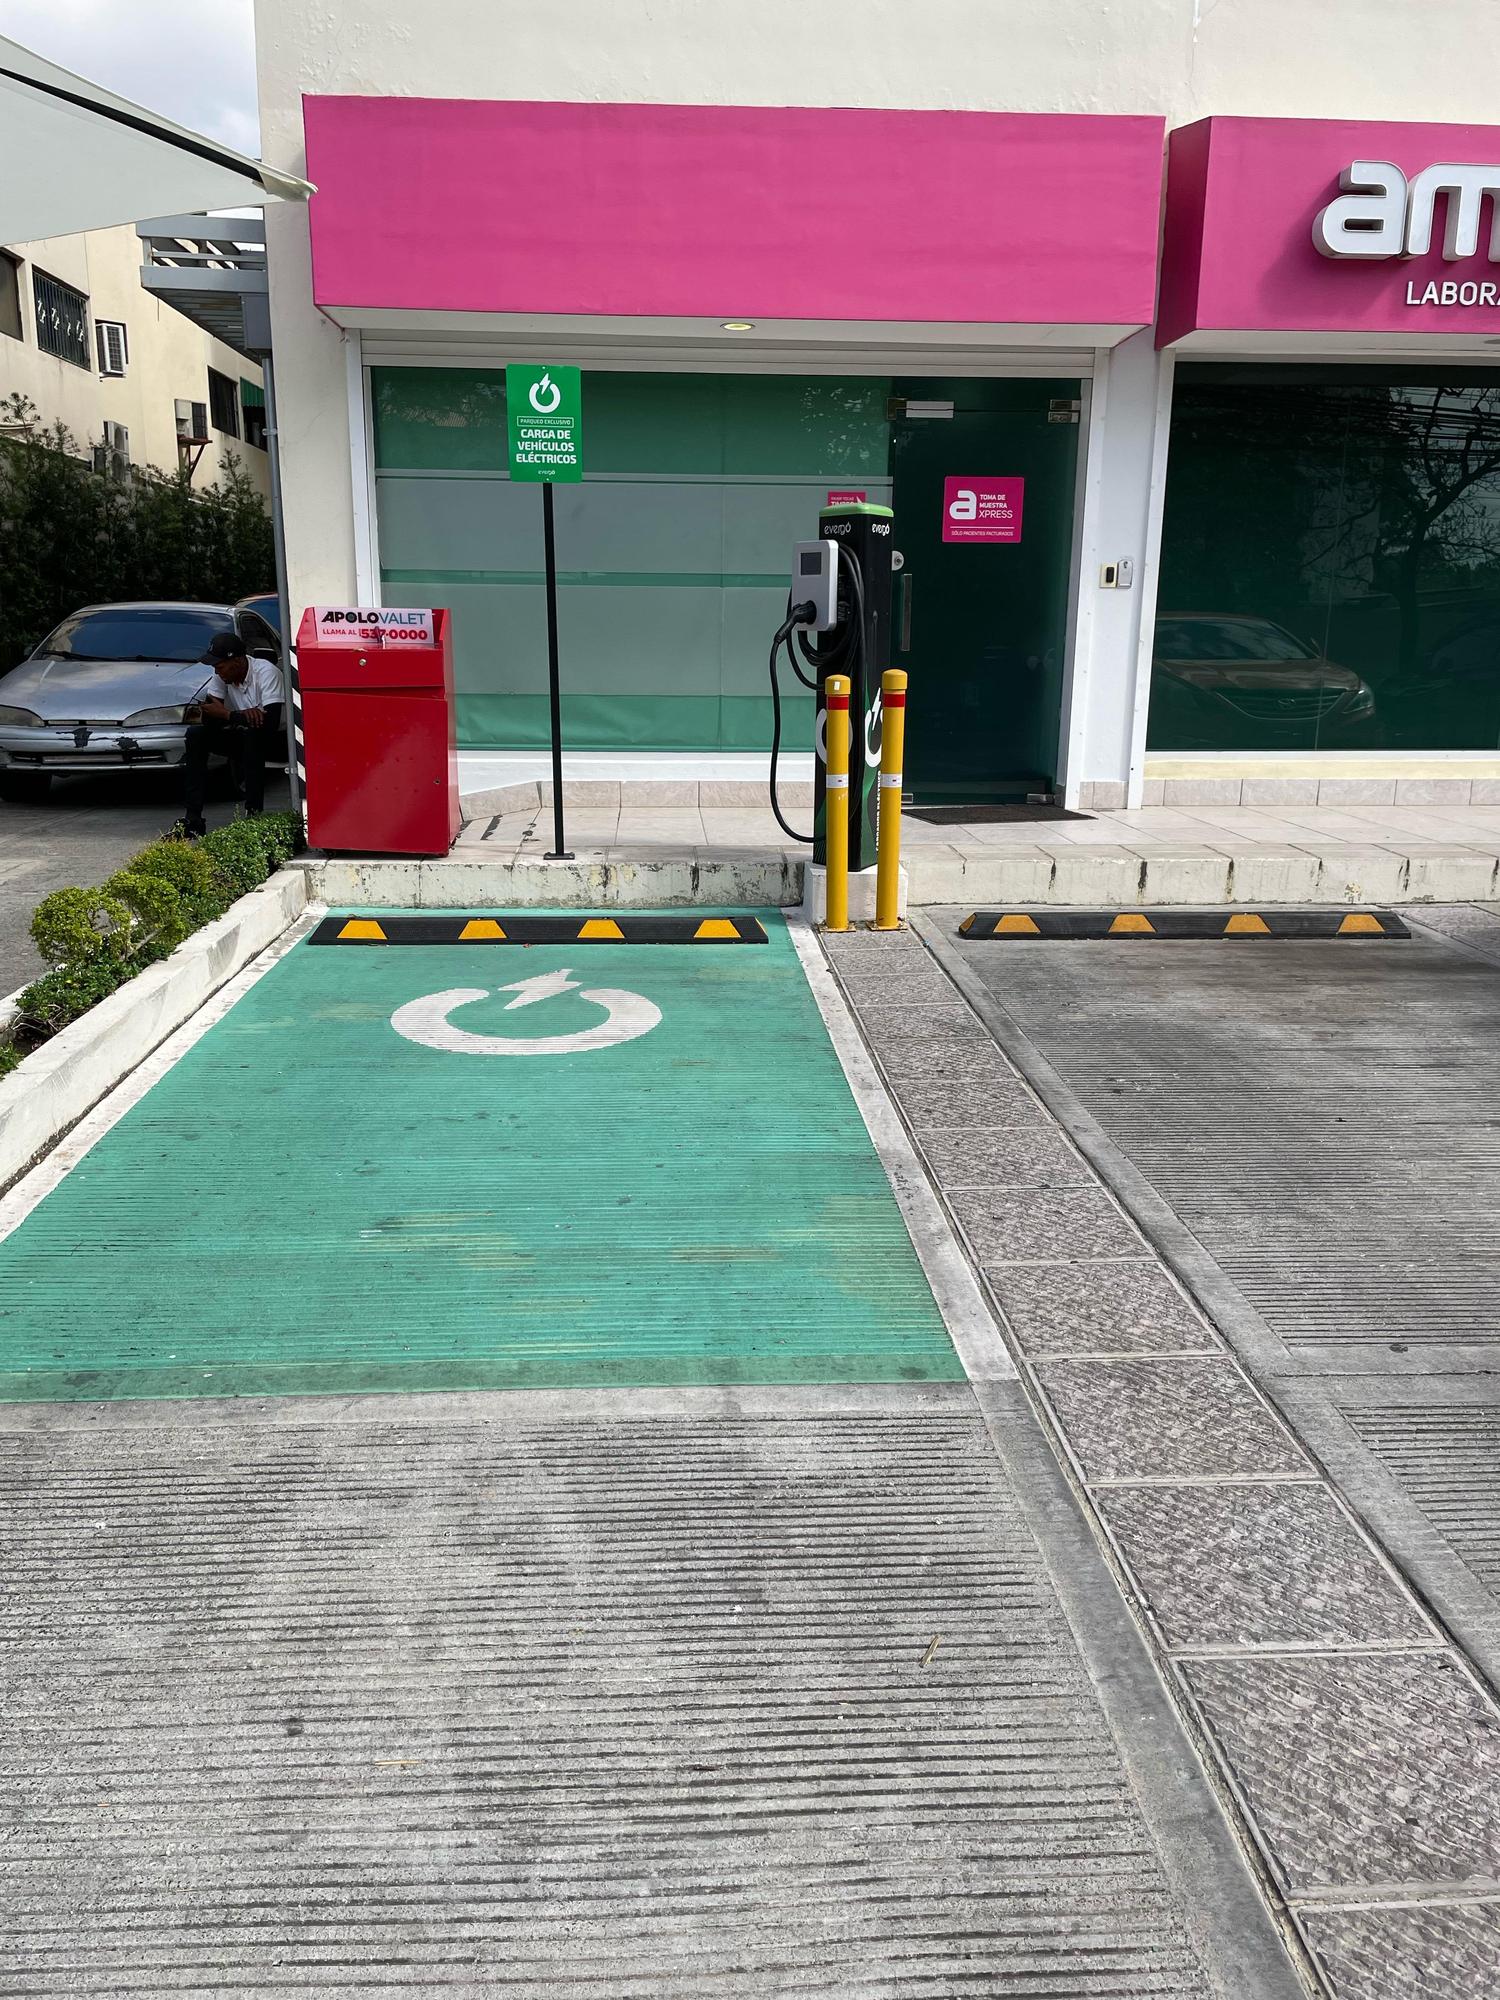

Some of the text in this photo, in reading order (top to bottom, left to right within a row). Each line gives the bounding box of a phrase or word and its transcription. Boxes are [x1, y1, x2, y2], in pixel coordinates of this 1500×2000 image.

[520, 429, 571, 440] CARGA DE
[517, 440, 575, 452] VEHÍCULOS
[516, 452, 577, 464] ELÉCTRICOS
[949, 490, 977, 520] a
[978, 510, 1013, 519] XPRESS
[322, 628, 347, 636] LLAMA
